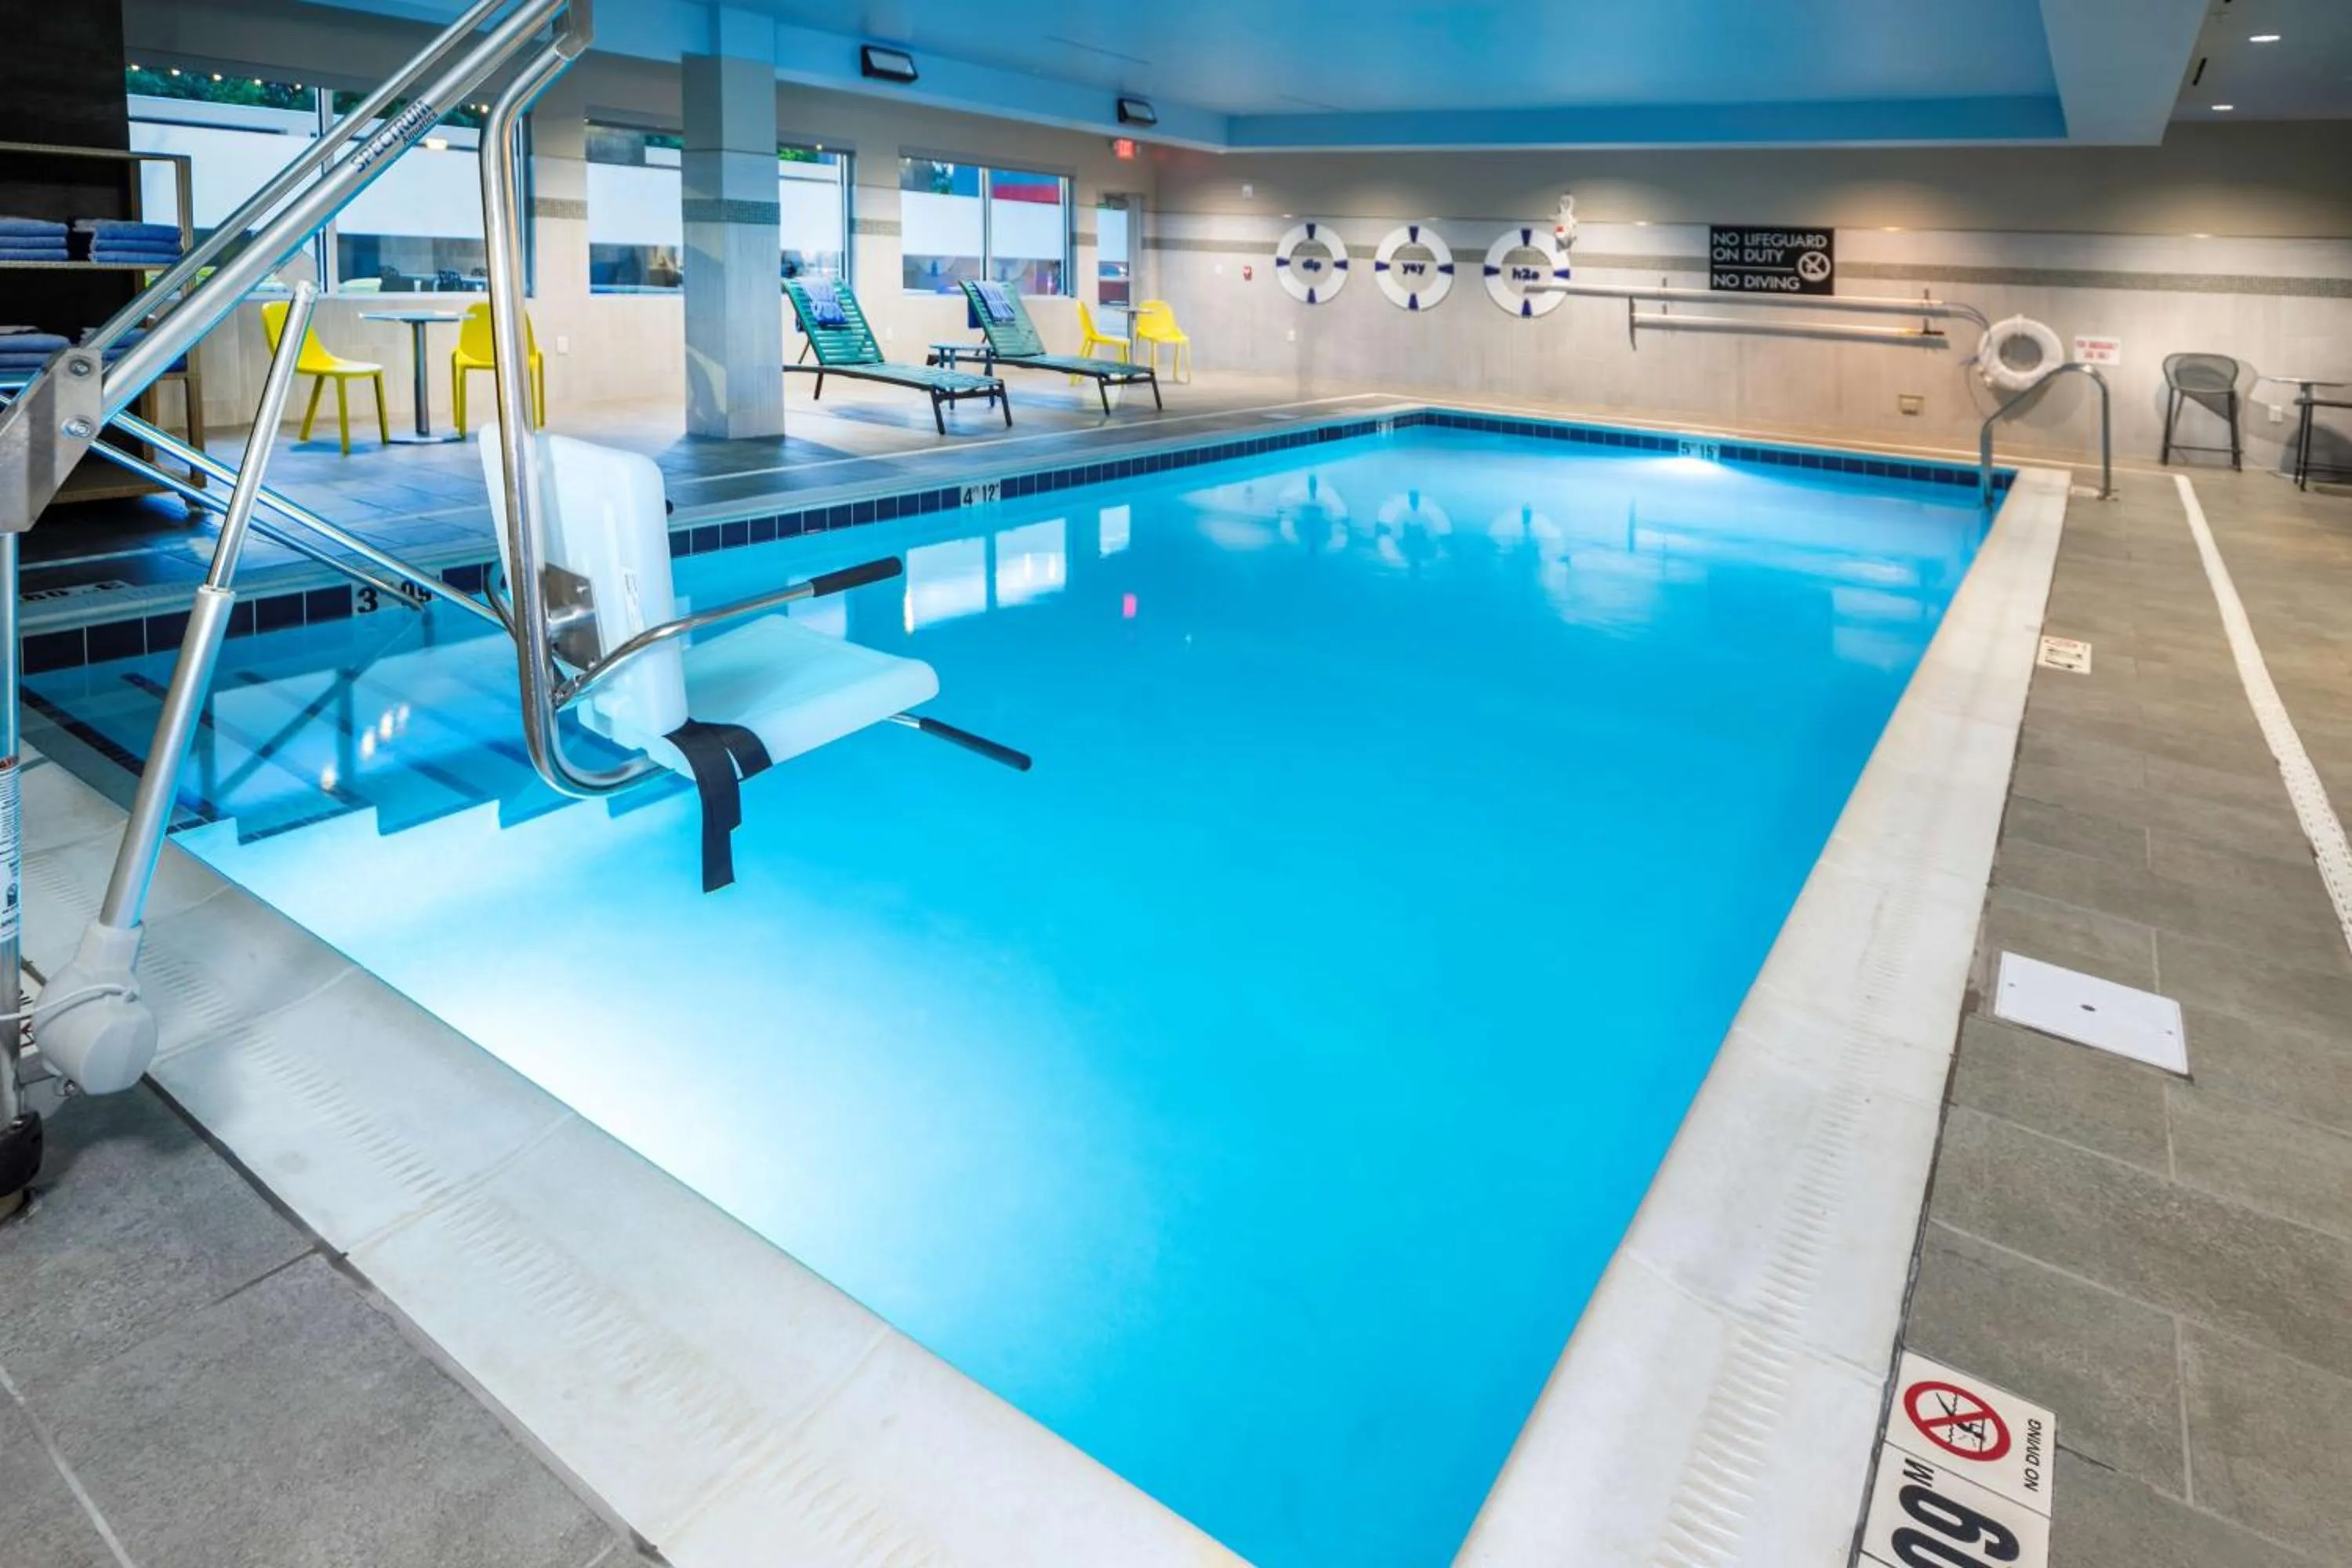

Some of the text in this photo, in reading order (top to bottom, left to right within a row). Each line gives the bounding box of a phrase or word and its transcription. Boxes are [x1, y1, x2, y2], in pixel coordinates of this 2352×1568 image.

[351, 100, 433, 172] SPECTRUM
[1713, 232, 1828, 249] NO LIFEGUARD
[1712, 248, 1784, 263] ON DUTY
[1713, 274, 1801, 290] NO DIVING
[2024, 1418, 2042, 1493] NO DIVING
